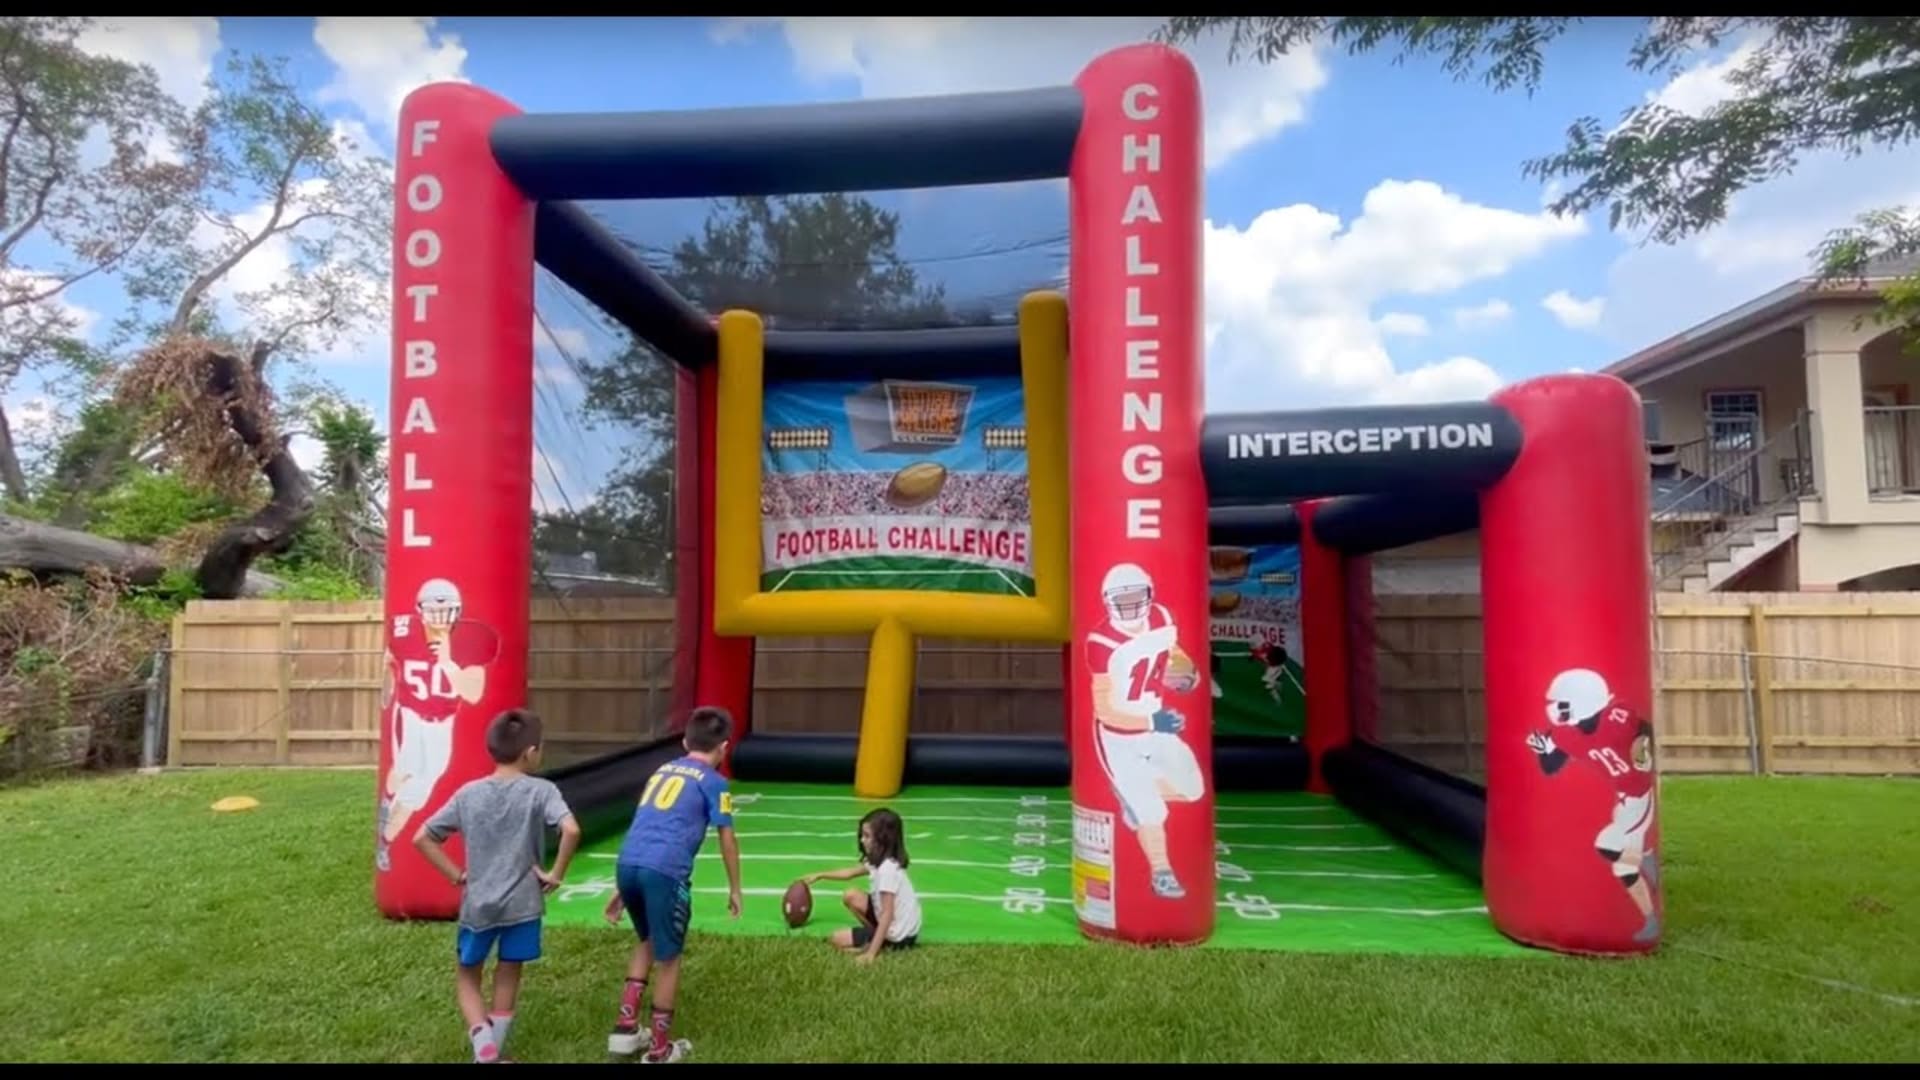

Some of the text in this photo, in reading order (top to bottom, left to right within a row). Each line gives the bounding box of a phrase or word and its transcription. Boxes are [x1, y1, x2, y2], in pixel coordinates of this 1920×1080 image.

[1121, 83, 1163, 539] CHALLENGE
[402, 119, 443, 547] FOOTBALL
[1228, 423, 1494, 459] INTERCEPTION
[776, 526, 1026, 562] FOOTBALL CHALLENGE
[1588, 747, 1630, 777] 23
[639, 772, 686, 811] 10
